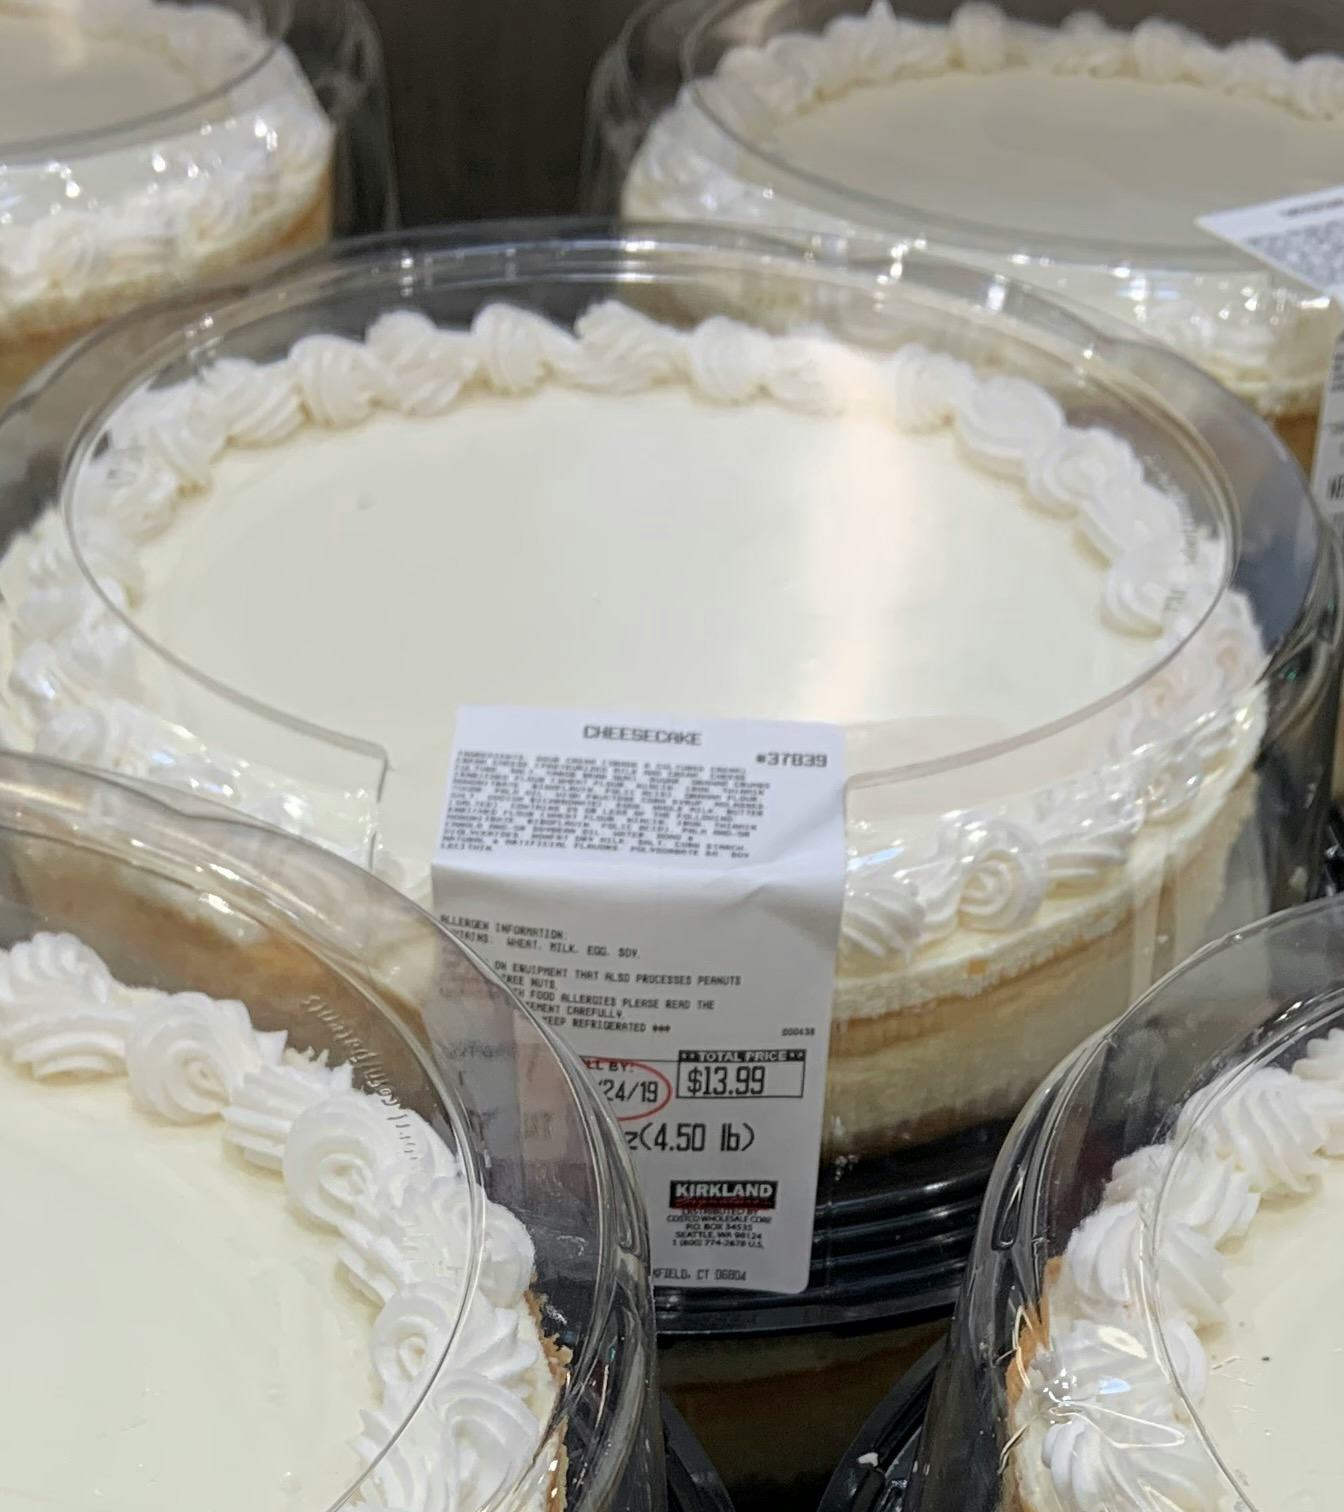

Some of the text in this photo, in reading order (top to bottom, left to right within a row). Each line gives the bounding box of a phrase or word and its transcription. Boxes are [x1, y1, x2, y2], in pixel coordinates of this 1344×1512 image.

[583, 725, 703, 746] CHEESECAKE
[576, 969, 741, 986] THAT ALSO PROCESSES PEANUTS
[622, 998, 659, 1010] PLEASE
[666, 999, 690, 1010] READ
[698, 1000, 715, 1010] THE
[572, 1016, 646, 1033] REFRIGERATED
[698, 1051, 787, 1062] TOTAL PRICE
[687, 1066, 765, 1096] $13.99
[720, 1123, 755, 1151] lb)
[676, 1183, 773, 1197] KIRKLAND
[697, 1270, 709, 1280] CT
